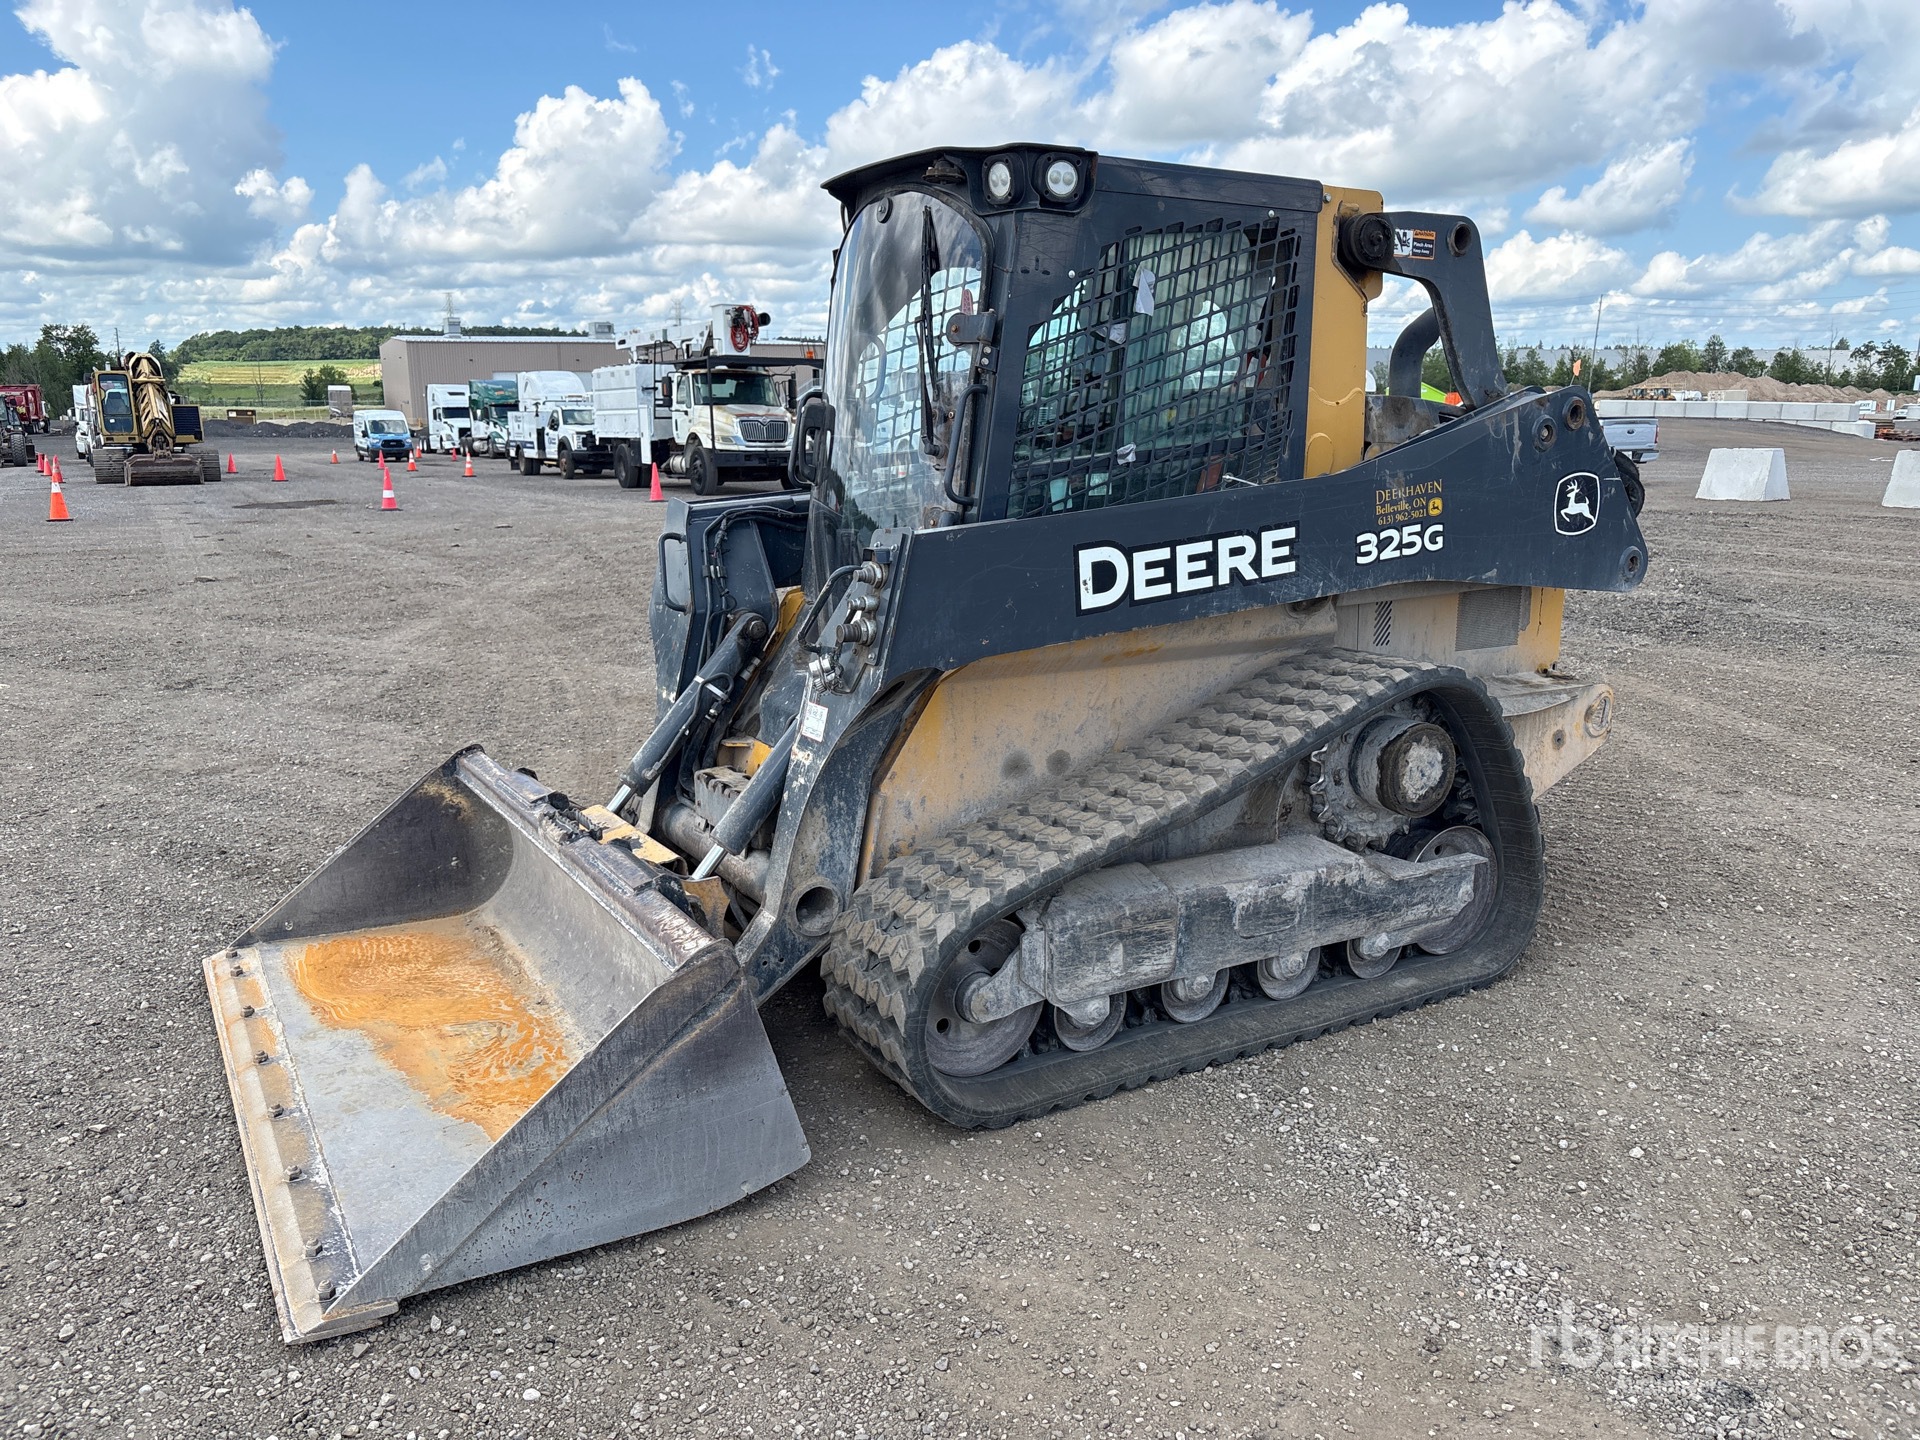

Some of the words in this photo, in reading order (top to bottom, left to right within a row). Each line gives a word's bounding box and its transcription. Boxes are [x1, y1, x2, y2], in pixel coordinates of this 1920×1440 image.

[1375, 478, 1442, 505] DEERHAVEN
[1375, 500, 1411, 515] Belleville,
[1413, 497, 1427, 508] ON
[1378, 514, 1394, 525] 613)
[1395, 508, 1427, 523] 962-5021
[1356, 523, 1444, 564] 325G
[1078, 526, 1297, 611] DEERE
